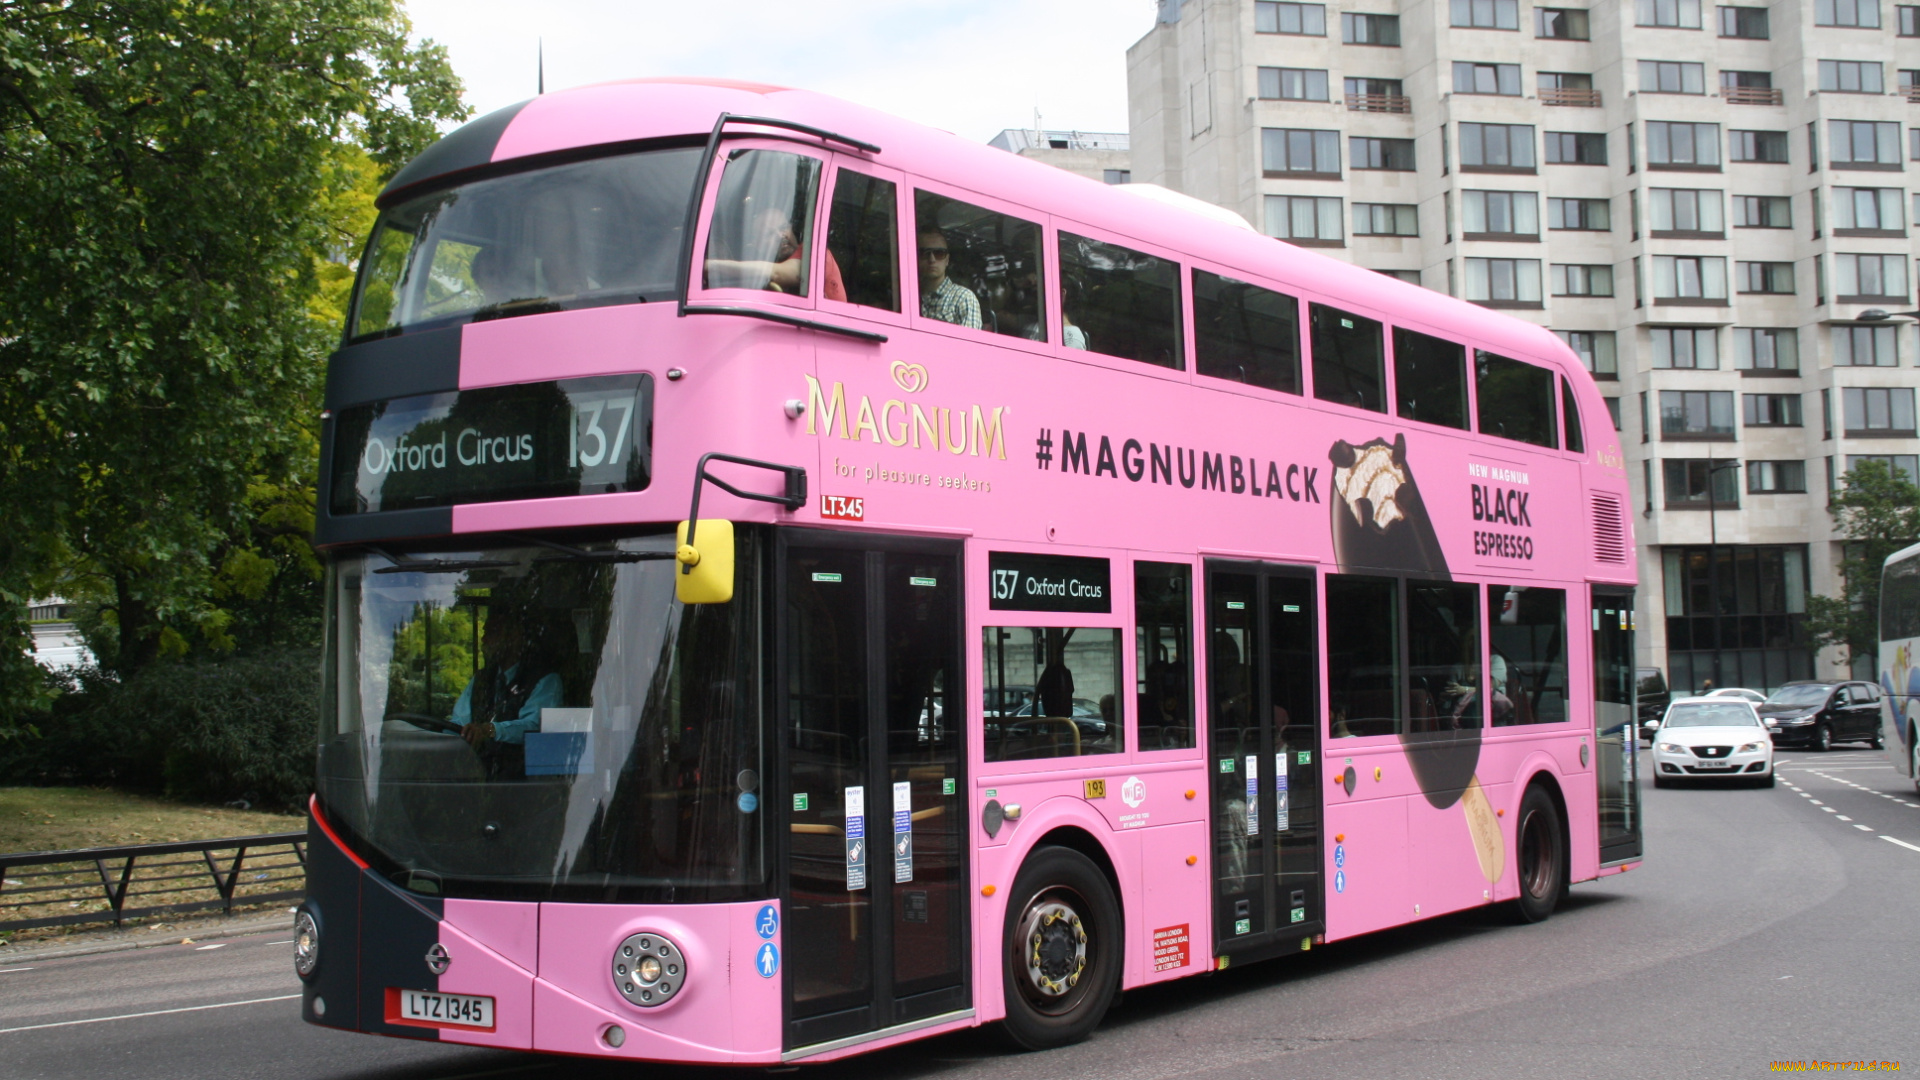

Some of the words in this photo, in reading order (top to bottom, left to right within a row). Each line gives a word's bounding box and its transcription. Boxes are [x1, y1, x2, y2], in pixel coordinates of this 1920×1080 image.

[804, 373, 1007, 460] MAGNUM
[569, 397, 635, 468] 137
[364, 430, 447, 475] Oxford
[456, 428, 534, 467] Circus
[1036, 428, 1320, 504] #MAGNUMBLACK
[834, 457, 857, 477] for
[865, 462, 931, 485] pleasure
[938, 472, 991, 493] seekers
[1468, 463, 1488, 478] NEW
[1491, 467, 1529, 485] MAGNUM
[821, 495, 863, 518] LT345
[1471, 483, 1532, 528] BLACK
[1474, 530, 1533, 560] ESPRESSO
[992, 569, 1019, 600] 137
[1025, 576, 1066, 597] Oxford
[1069, 578, 1102, 598] Circus
[1087, 781, 1104, 797] 193
[1168, 928, 1182, 937] LONDON
[410, 994, 441, 1018] LTZ
[446, 997, 482, 1022] 1345
